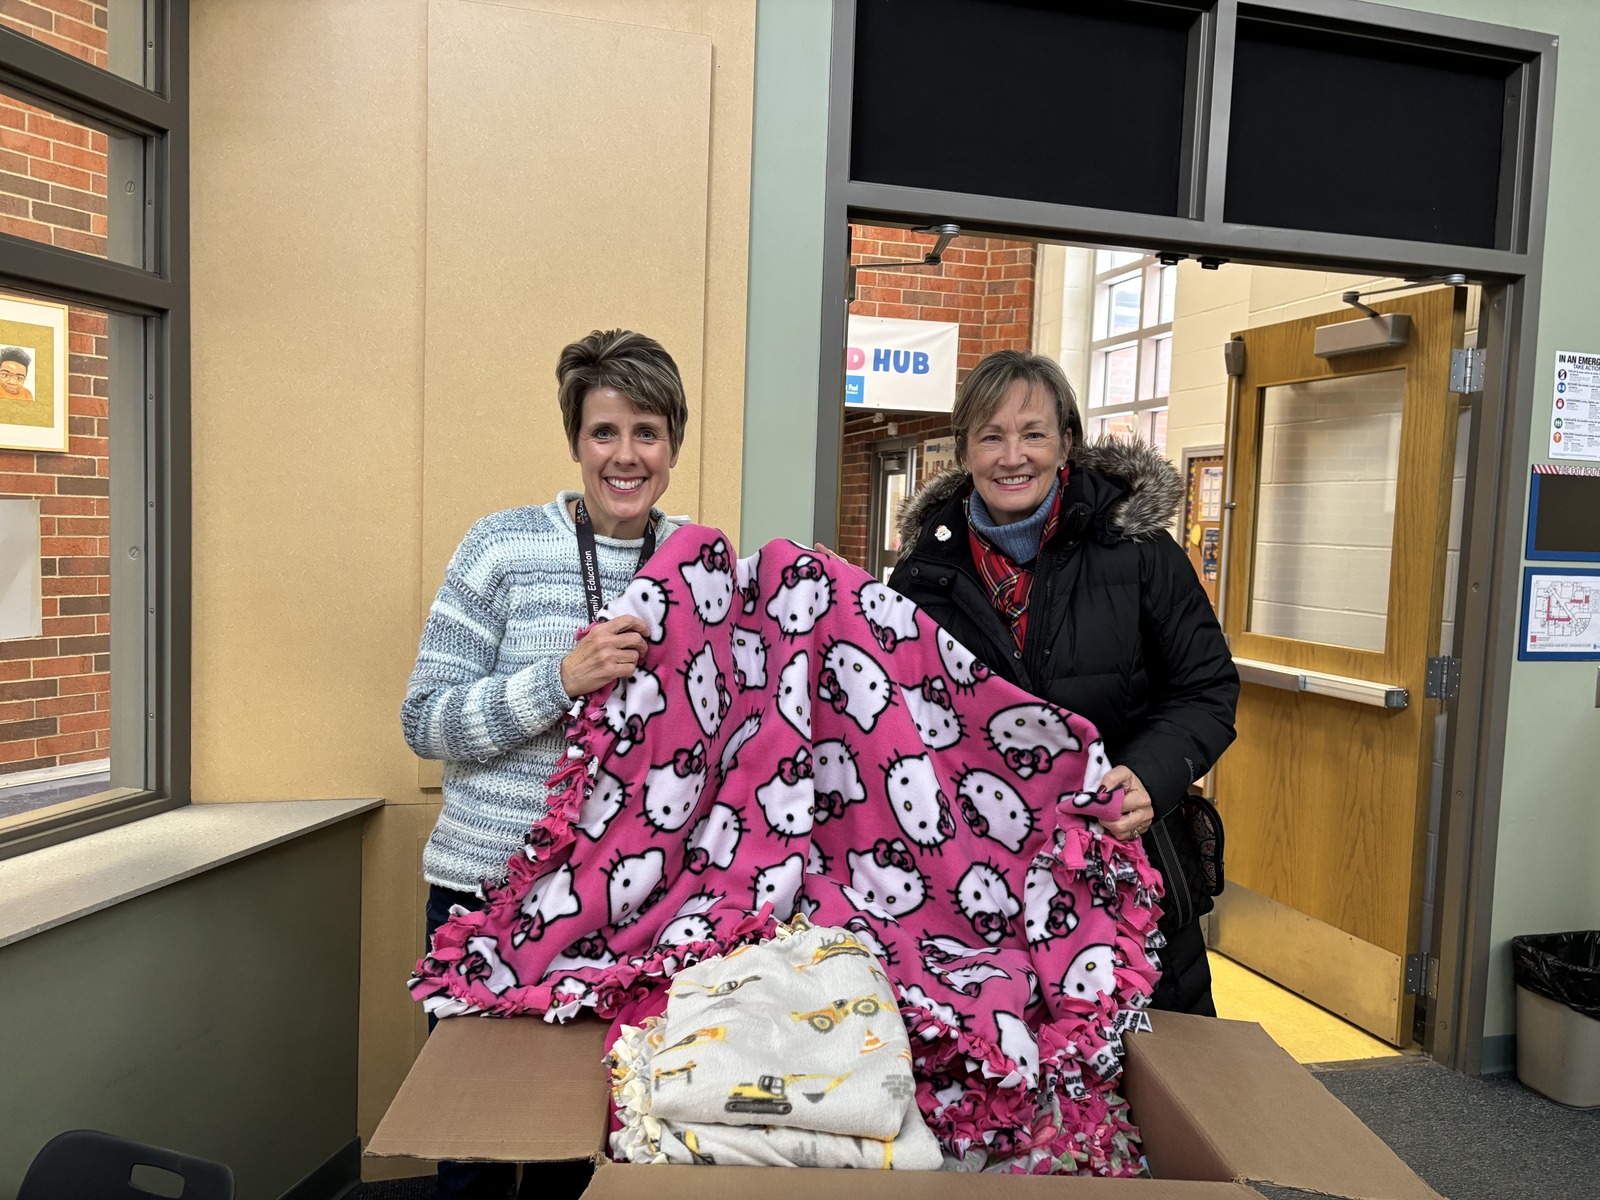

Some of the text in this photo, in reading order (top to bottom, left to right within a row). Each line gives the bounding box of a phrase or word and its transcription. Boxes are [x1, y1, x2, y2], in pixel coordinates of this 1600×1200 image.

[873, 348, 930, 374] HUB
[1559, 355, 1566, 363] IN
[1567, 355, 1577, 364] AN
[584, 550, 596, 591] Education
